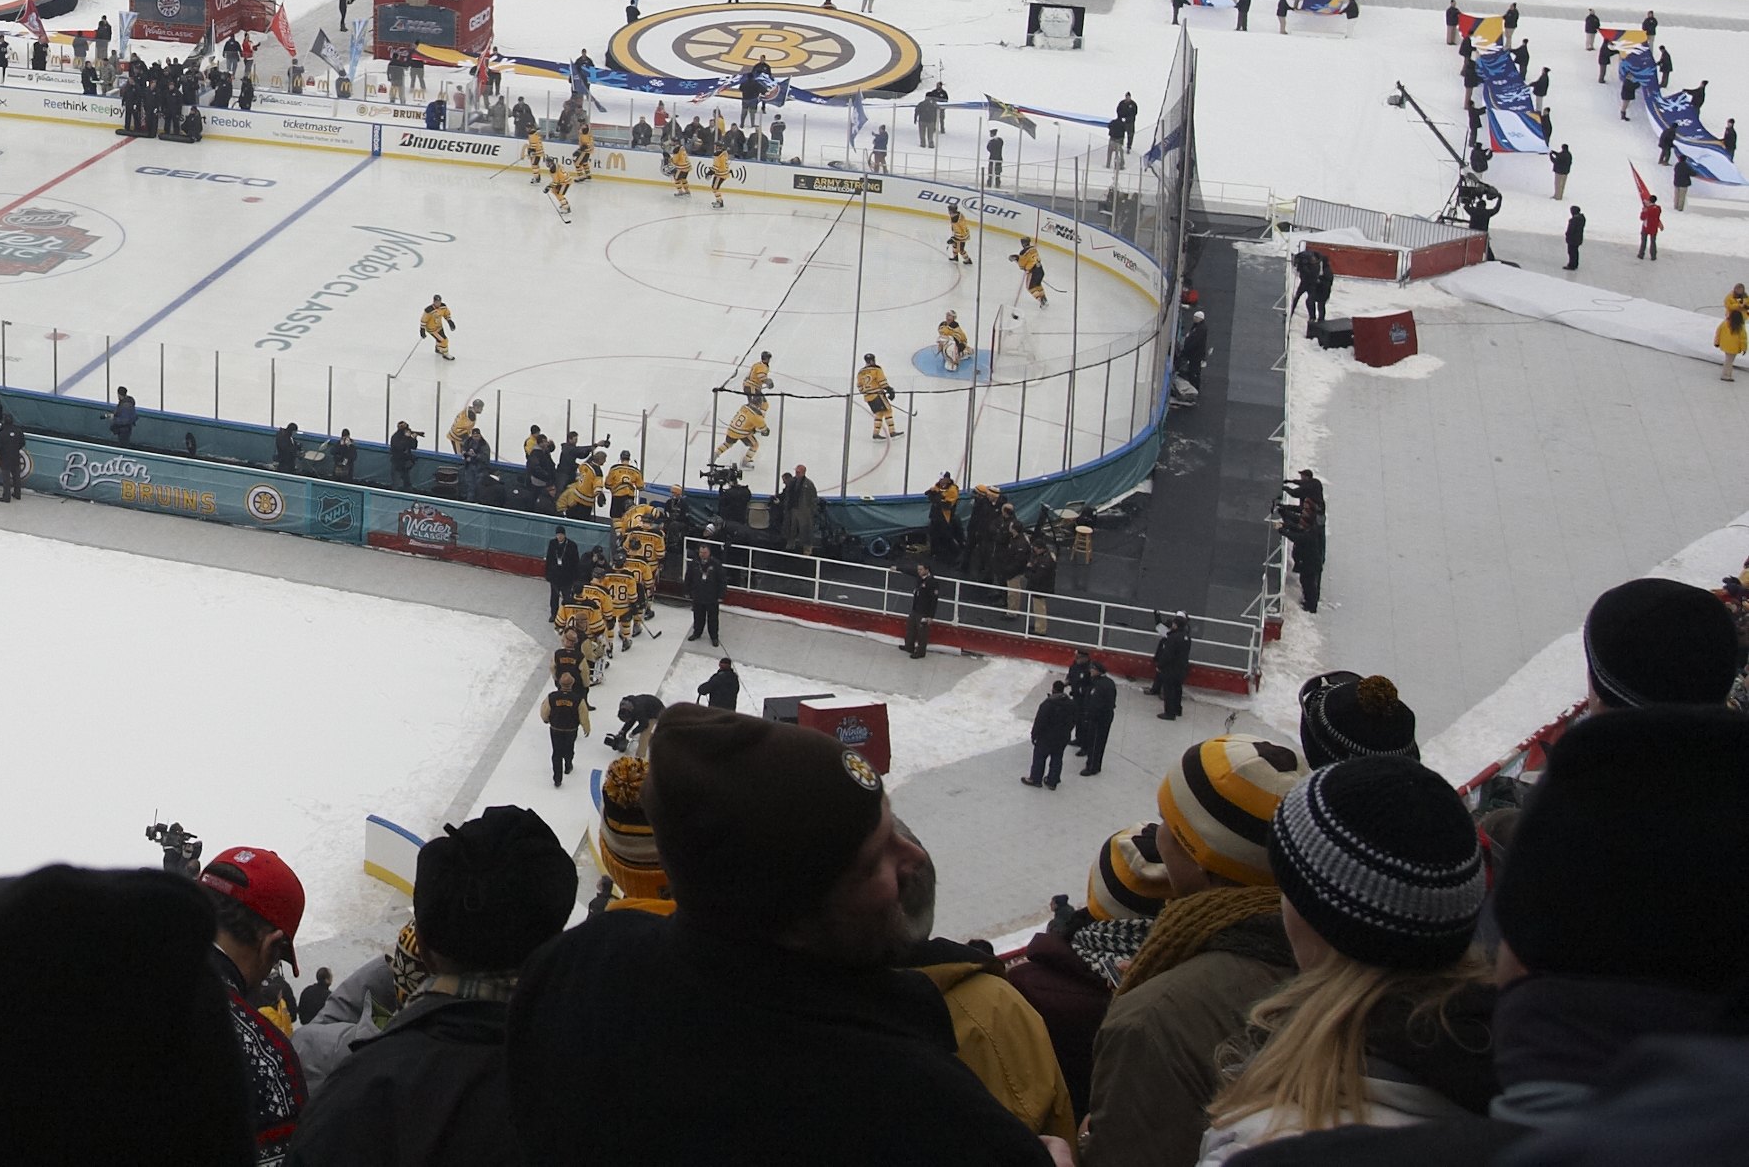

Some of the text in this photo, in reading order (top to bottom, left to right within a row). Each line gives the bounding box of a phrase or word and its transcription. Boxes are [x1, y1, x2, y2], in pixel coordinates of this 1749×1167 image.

[469, 6, 491, 31] GEICO
[43, 98, 88, 112] Reethink
[91, 103, 125, 118] Reejoy
[211, 115, 252, 129] Reebok
[283, 119, 342, 134] ticketmaster
[398, 133, 501, 157] BRIDGESTONE
[593, 158, 602, 169] it
[135, 166, 277, 187] GEICO
[813, 177, 881, 192] ARMY STRONG
[917, 190, 1021, 220] BUD LIGHT
[254, 224, 457, 352] Winter CLASSIC
[121, 479, 218, 515] BRUINS
[322, 506, 349, 523] NHL
[402, 514, 452, 536] Winter
[412, 529, 450, 542] CLASSIC
[609, 585, 628, 602] 48
